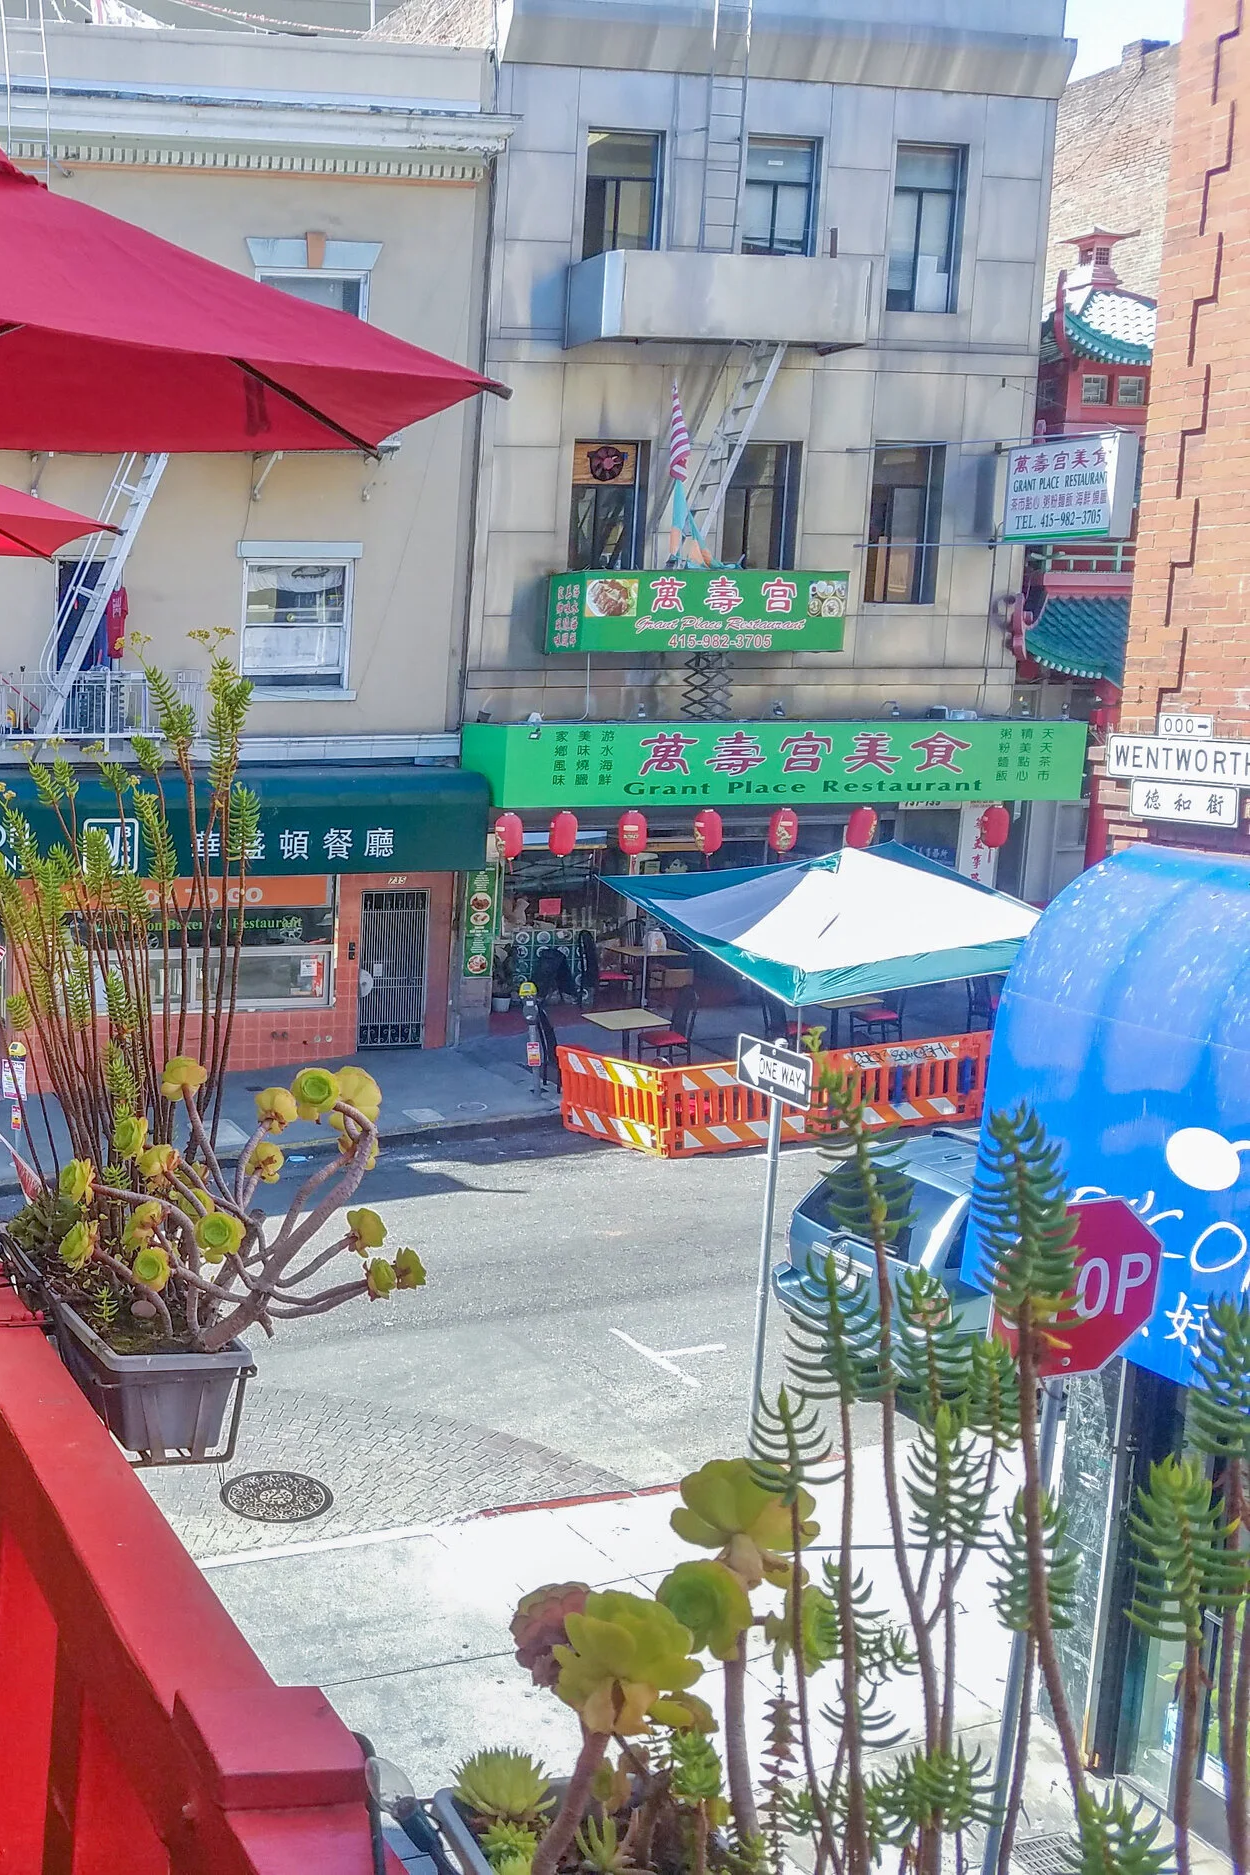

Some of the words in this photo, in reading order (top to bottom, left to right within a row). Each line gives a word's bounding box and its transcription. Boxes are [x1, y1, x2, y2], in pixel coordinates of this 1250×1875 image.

[1013, 477, 1037, 493] GRANT
[1038, 475, 1061, 491] PLACE
[1064, 471, 1108, 488] RESTAURANT
[1015, 514, 1037, 530] TEL.
[1040, 508, 1102, 528] 415-982-3705
[635, 615, 679, 635] Grant
[679, 615, 723, 631] Place
[725, 615, 807, 632] Restaurant
[668, 633, 773, 649] 415-982-3705
[623, 781, 711, 796] Grant
[727, 780, 806, 795] Place
[823, 778, 983, 793] Restaurant
[228, 887, 263, 903] GO
[167, 918, 212, 932] Baker
[759, 1057, 777, 1080] ONE
[781, 1066, 802, 1088] WAY
